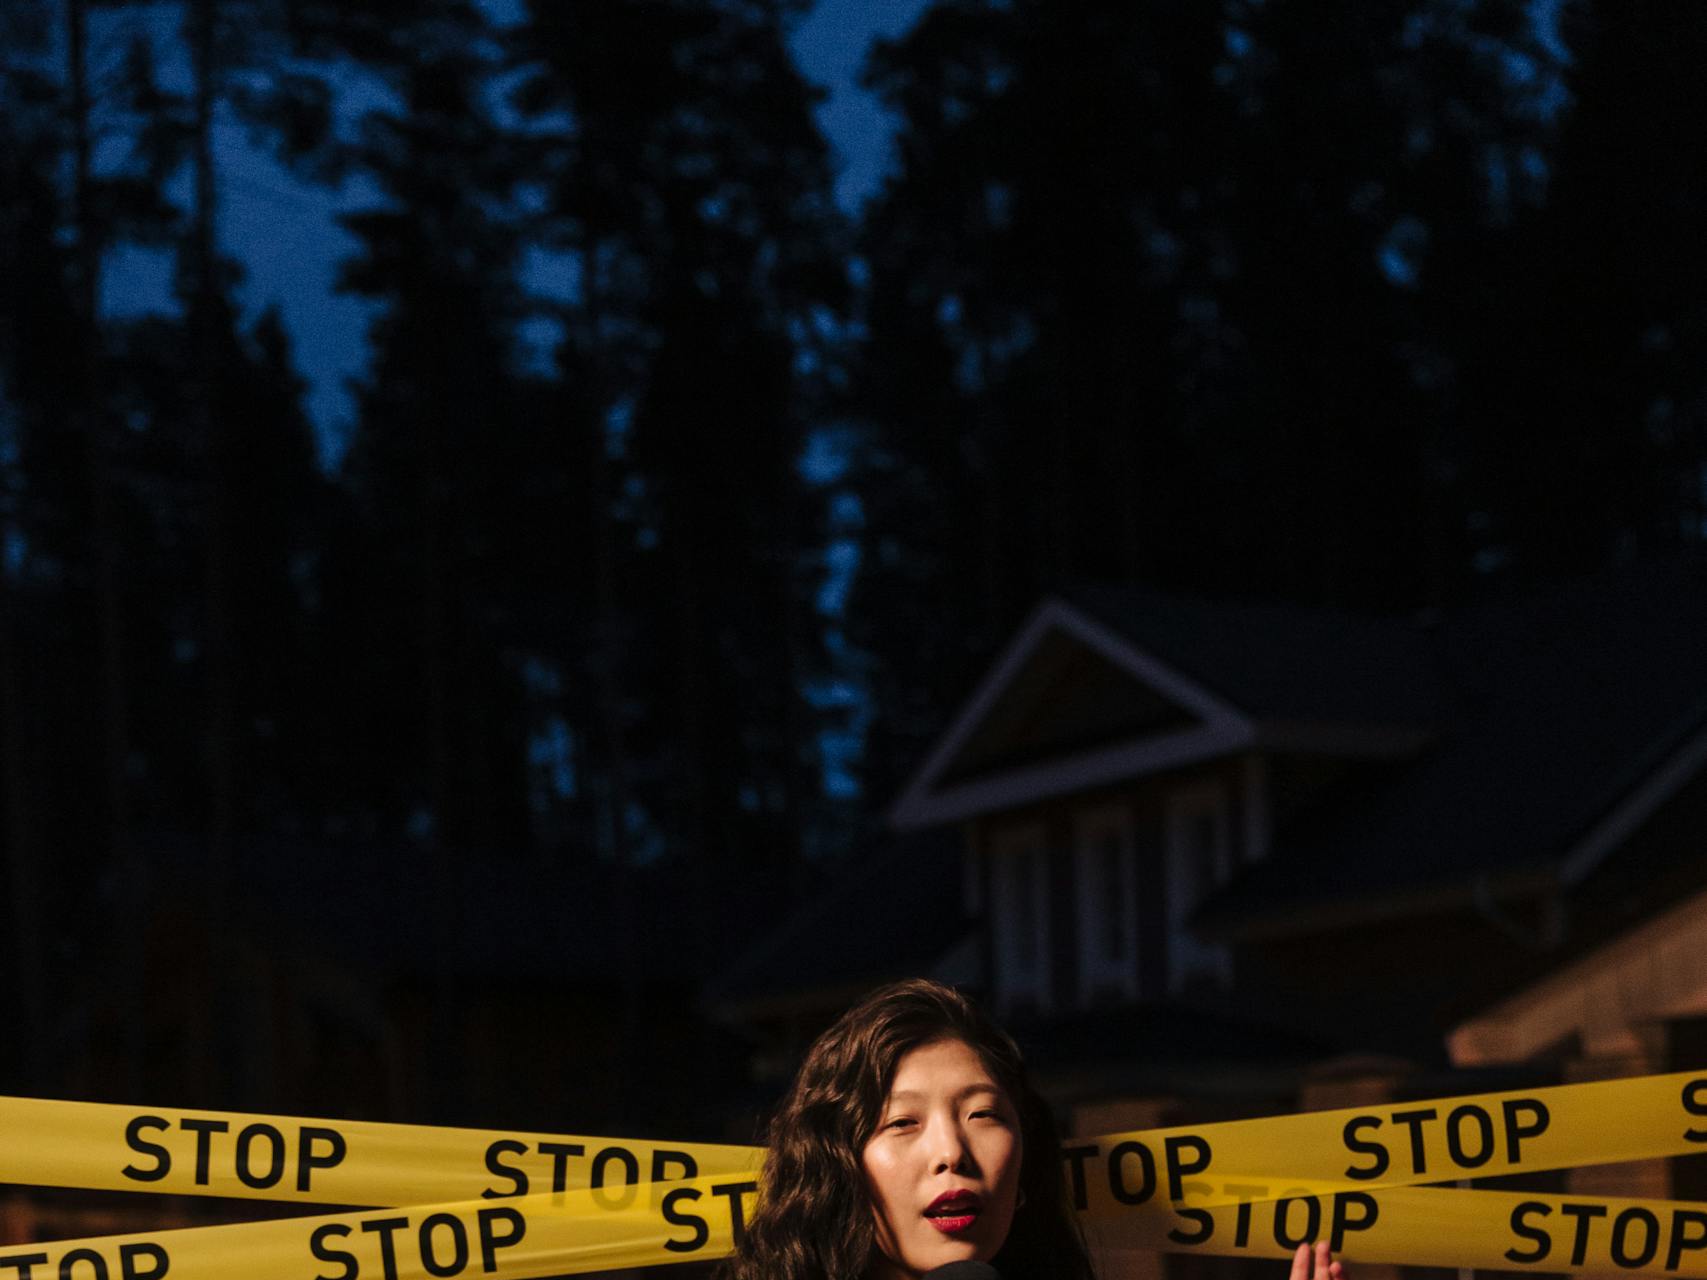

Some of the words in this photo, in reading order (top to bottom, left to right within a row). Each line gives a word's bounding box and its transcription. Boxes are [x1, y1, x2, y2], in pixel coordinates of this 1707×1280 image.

[122, 1116, 346, 1191] STOP
[1062, 1136, 1212, 1210] TOP
[1344, 1099, 1550, 1180] STOP
[662, 1183, 757, 1252] ST
[1505, 1202, 1707, 1271] STOP
